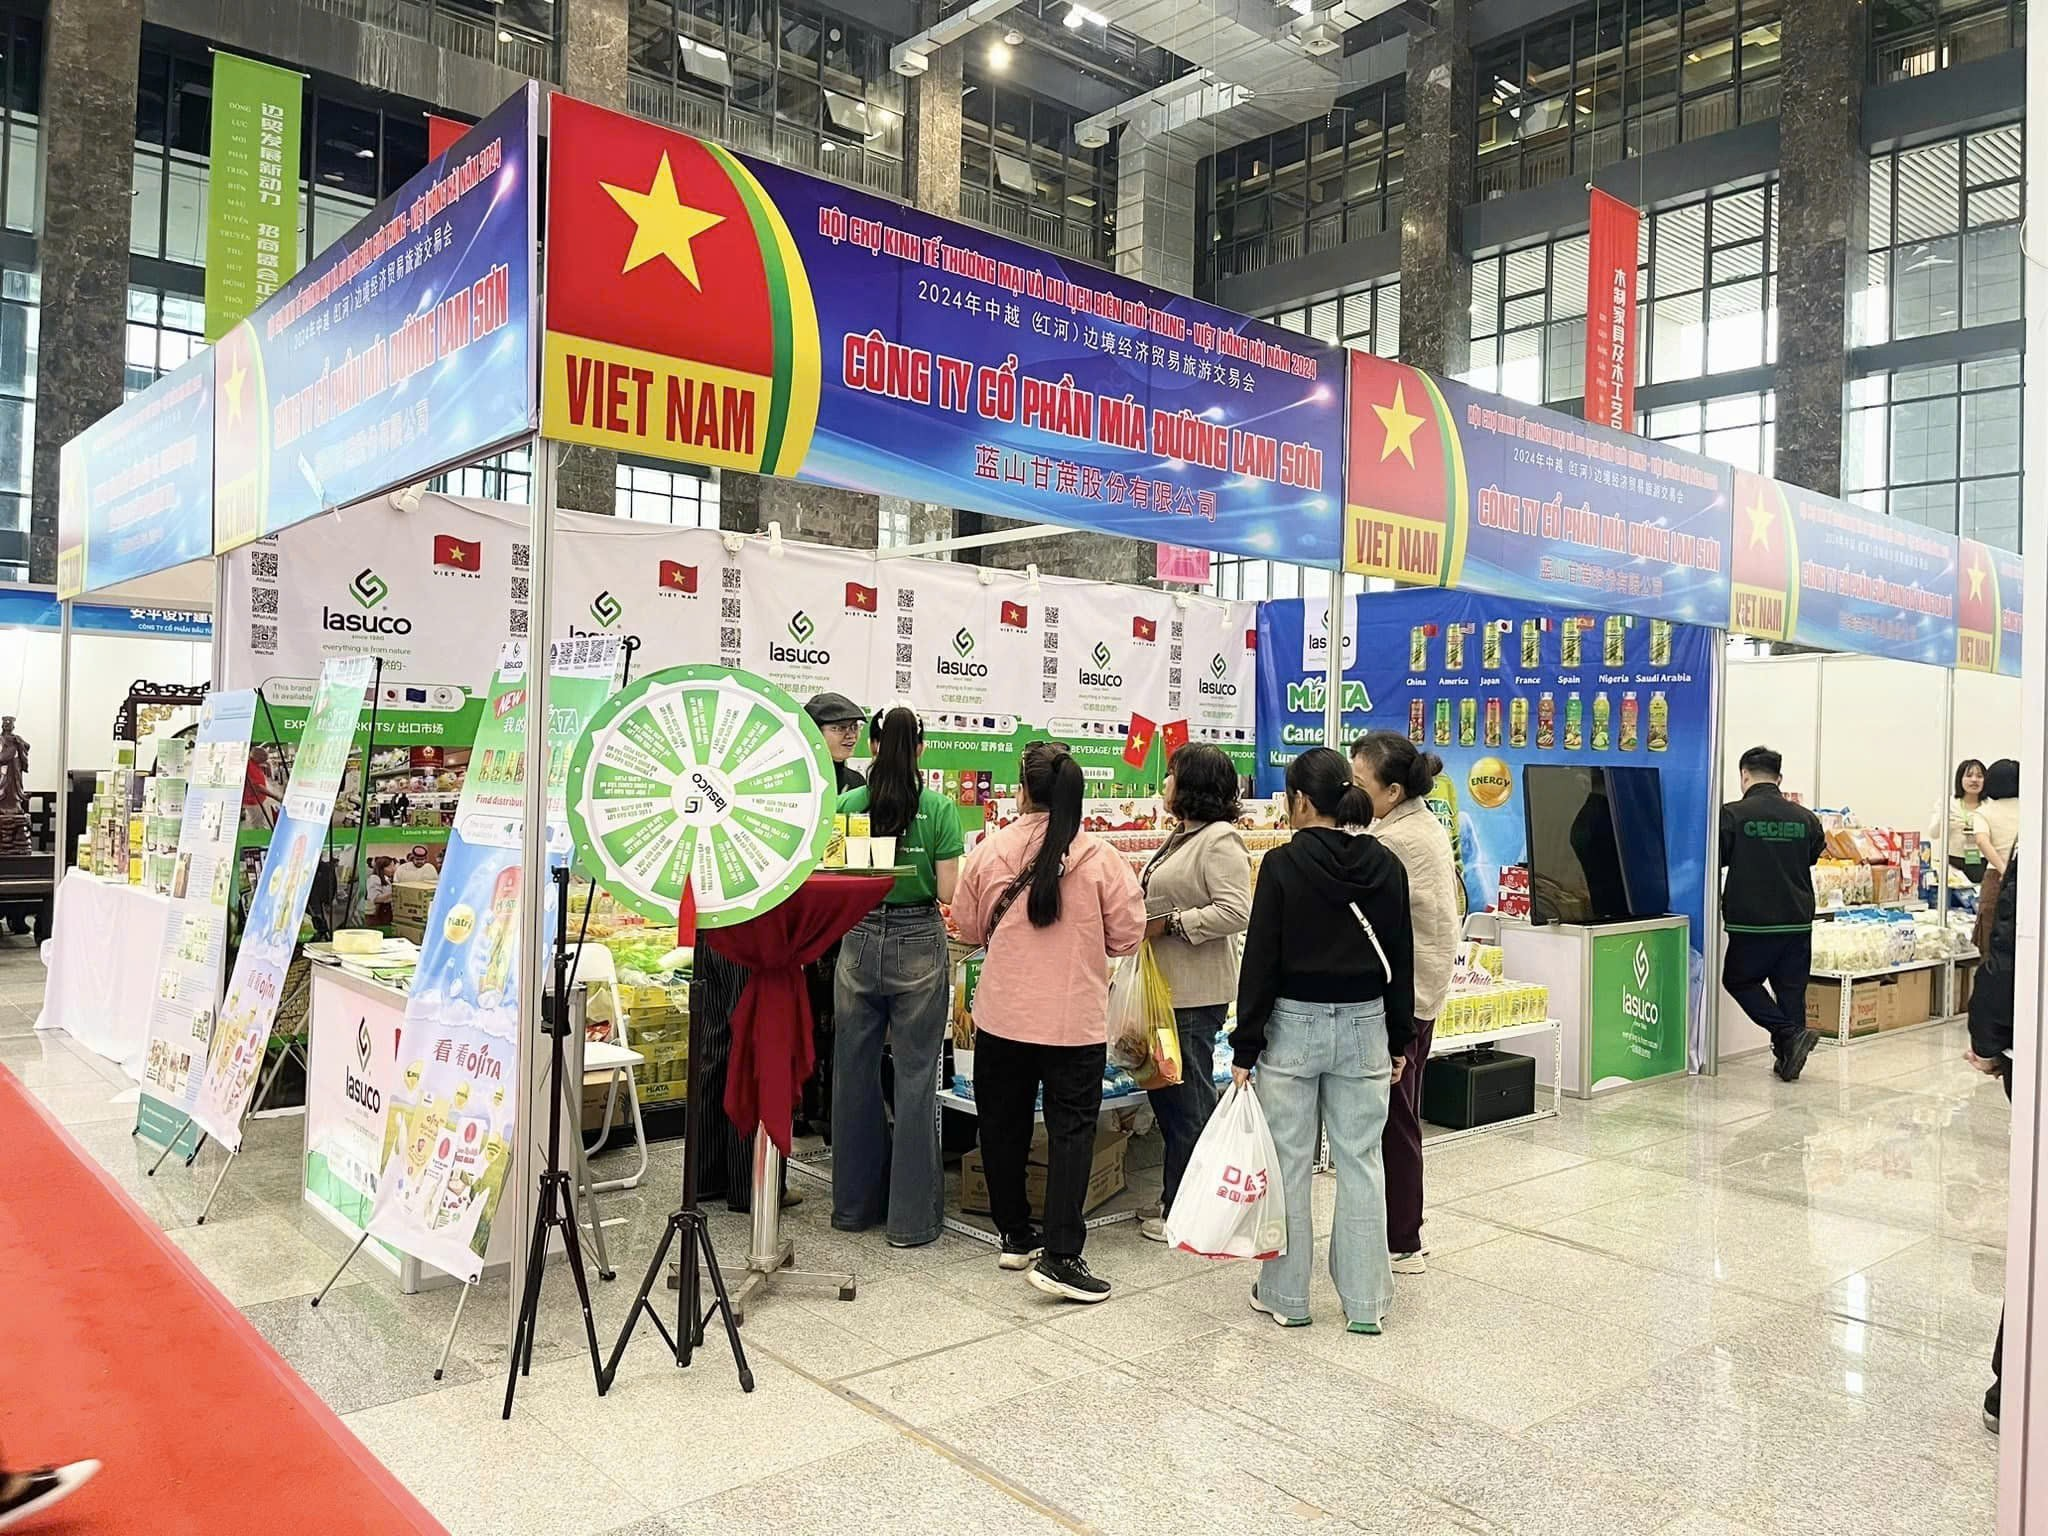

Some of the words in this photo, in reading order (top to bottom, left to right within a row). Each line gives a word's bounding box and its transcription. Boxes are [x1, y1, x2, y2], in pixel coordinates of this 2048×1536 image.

[259, 102, 284, 206] 边贸发展新动力
[819, 206, 847, 245] HỘI
[849, 216, 882, 257] CHỢ
[884, 225, 921, 263] KINH
[923, 236, 943, 267] TẾ
[942, 245, 996, 285] THƯƠNG
[998, 262, 1026, 298] MẠI
[1027, 269, 1045, 300] VÀ
[1046, 276, 1064, 304] DU
[1065, 281, 1092, 315] LỊCH
[1094, 291, 1122, 322] BIÊN
[1123, 299, 1148, 329] GIỚI
[1148, 307, 1186, 342] TRUNG
[1193, 321, 1216, 353] VIỆT
[1266, 343, 1291, 372] NĂM
[1291, 353, 1317, 381] 2024
[437, 286, 471, 362] LAM
[472, 262, 509, 341] SƠN
[566, 354, 654, 437] VIET
[667, 375, 755, 455] NAM
[842, 328, 932, 406] CÔNG
[936, 355, 972, 415] TY
[977, 354, 1018, 424] CỔ
[1022, 373, 1093, 440] PHẦN
[1098, 395, 1147, 454] MÍA
[1152, 408, 1228, 471] ĐƯỜNG
[1231, 428, 1277, 482] LAM
[1279, 441, 1323, 492] SƠN
[974, 443, 1217, 522] 蓝山甘蔗股份有限公司
[1477, 485, 1520, 536] CÔNG
[1522, 499, 1541, 537] TY
[1541, 492, 1563, 541] CỔ
[1563, 500, 1600, 547] PHẦN
[1670, 532, 1696, 567] LAM
[1355, 518, 1393, 568] VIET
[1398, 526, 1439, 576] NAM
[323, 606, 412, 635] lasuco
[1736, 592, 1757, 628] VIET
[1759, 596, 1782, 633] NAM
[322, 644, 361, 653] everything
[370, 646, 387, 654] from
[1309, 634, 1350, 650] laso
[770, 641, 830, 665] lasuco
[504, 659, 524, 670] lasuco
[937, 656, 988, 677] lasuco
[274, 683, 289, 692] This
[291, 684, 313, 693] brand
[1079, 668, 1123, 688] lasuco
[1199, 678, 1237, 696] lasuco
[1406, 678, 1427, 687] China
[1439, 677, 1469, 686] America
[1480, 677, 1500, 687] Japan
[1515, 675, 1541, 685] France
[1557, 675, 1580, 686] Spain
[1598, 673, 1630, 685] Nigeria
[1635, 672, 1660, 683] Saudi
[1661, 672, 1691, 683] Arabia
[280, 693, 314, 701] available
[498, 690, 521, 716] NEW
[284, 719, 306, 729] EXP
[398, 721, 444, 735] 出口市场
[1283, 724, 1325, 744] Cane
[925, 740, 952, 749] RITION
[1071, 744, 1110, 755] BEVERAGE/
[1230, 751, 1256, 759] PRODUC
[691, 772, 729, 813] lasuco
[1470, 776, 1512, 789] ENERGY
[476, 794, 492, 804] Find
[493, 796, 525, 807] distribut
[1622, 984, 1659, 1025] lasuco
[345, 1065, 381, 1114] lasuco
